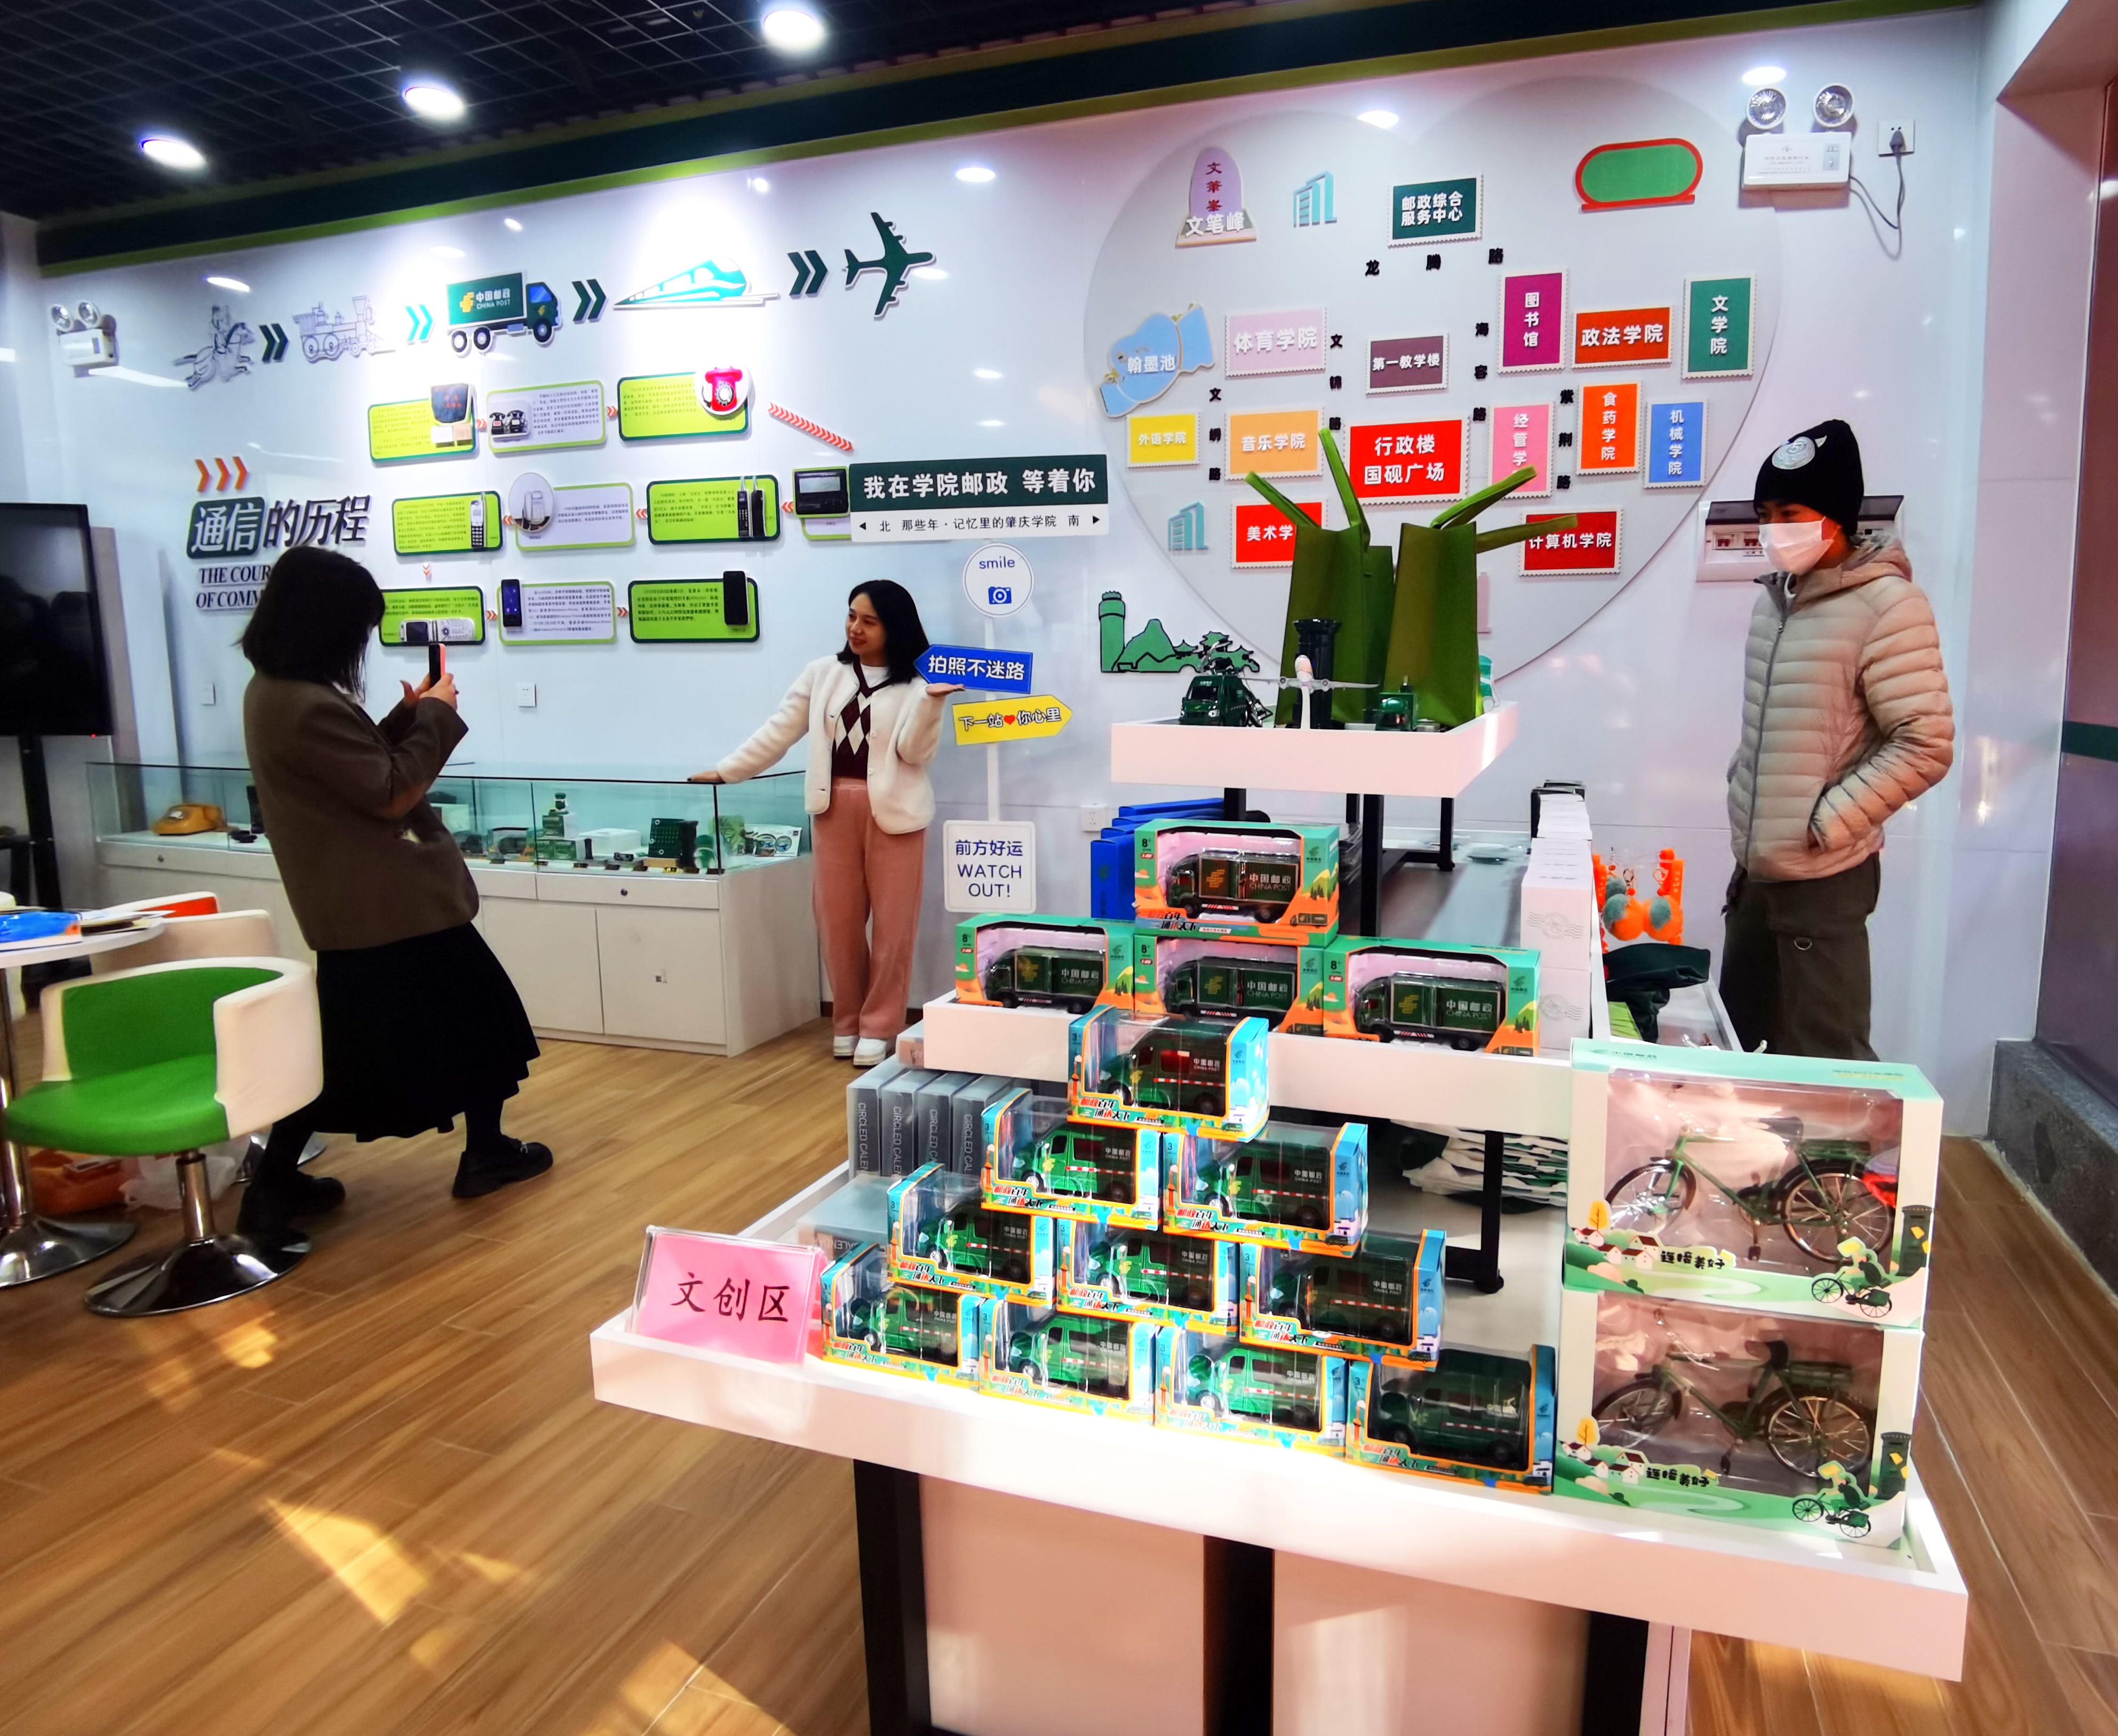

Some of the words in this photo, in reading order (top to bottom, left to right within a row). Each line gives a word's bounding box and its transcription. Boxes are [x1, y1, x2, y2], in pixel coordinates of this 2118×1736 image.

[1401, 190, 1464, 211] 邮政综合
[1185, 211, 1245, 238] 文笔峰
[1400, 207, 1463, 227] 服务中心
[476, 288, 511, 301] 中国邮政
[476, 300, 495, 309] CHINA
[496, 299, 511, 307] POST
[1523, 291, 1540, 348] 图书馆
[1709, 295, 1729, 355] 文学院
[1234, 327, 1318, 354] 体育学院
[1581, 323, 1664, 347] 政法学院
[1127, 355, 1176, 374] 翰墨池
[1372, 352, 1440, 372] 第一教学楼
[1601, 392, 1617, 461] 食药学院
[1138, 431, 1187, 447] 外语学院
[1241, 432, 1307, 452] 音乐学院
[1374, 433, 1436, 456] 行政楼
[1512, 413, 1529, 473] 经管学
[1668, 409, 1684, 476] 机械学院
[864, 469, 1008, 499] 我在学院邮政
[1022, 468, 1096, 494] 等着你
[1364, 462, 1445, 485] 国砚广场
[191, 494, 371, 554] 通信的历程
[880, 520, 891, 532] 北
[1068, 514, 1080, 527] 南
[1247, 524, 1293, 542] 美术学
[1529, 531, 1612, 550] 计算机学院
[979, 556, 1015, 569] smile
[199, 567, 227, 585] THE
[196, 591, 217, 608] OF
[928, 655, 1025, 681] 拍照不迷路
[959, 713, 1004, 731] 下一站
[1017, 707, 1062, 726] 你心里
[955, 839, 1023, 856] 前方好运
[957, 864, 1022, 879] WATCH
[1249, 873, 1292, 885] 中国邮政
[968, 883, 1010, 897] OUT!
[1061, 968, 1100, 981] 中国邮政
[1247, 981, 1289, 993] 中国邮政
[1271, 991, 1288, 999] POST
[1446, 999, 1492, 1013] 中国邮政
[857, 1102, 868, 1141] CIRCLED
[893, 1106, 902, 1145] CIRCLED
[929, 1109, 938, 1148] CIRCLED
[964, 1114, 973, 1154] CIRCLED
[670, 1271, 790, 1322] 文创区
